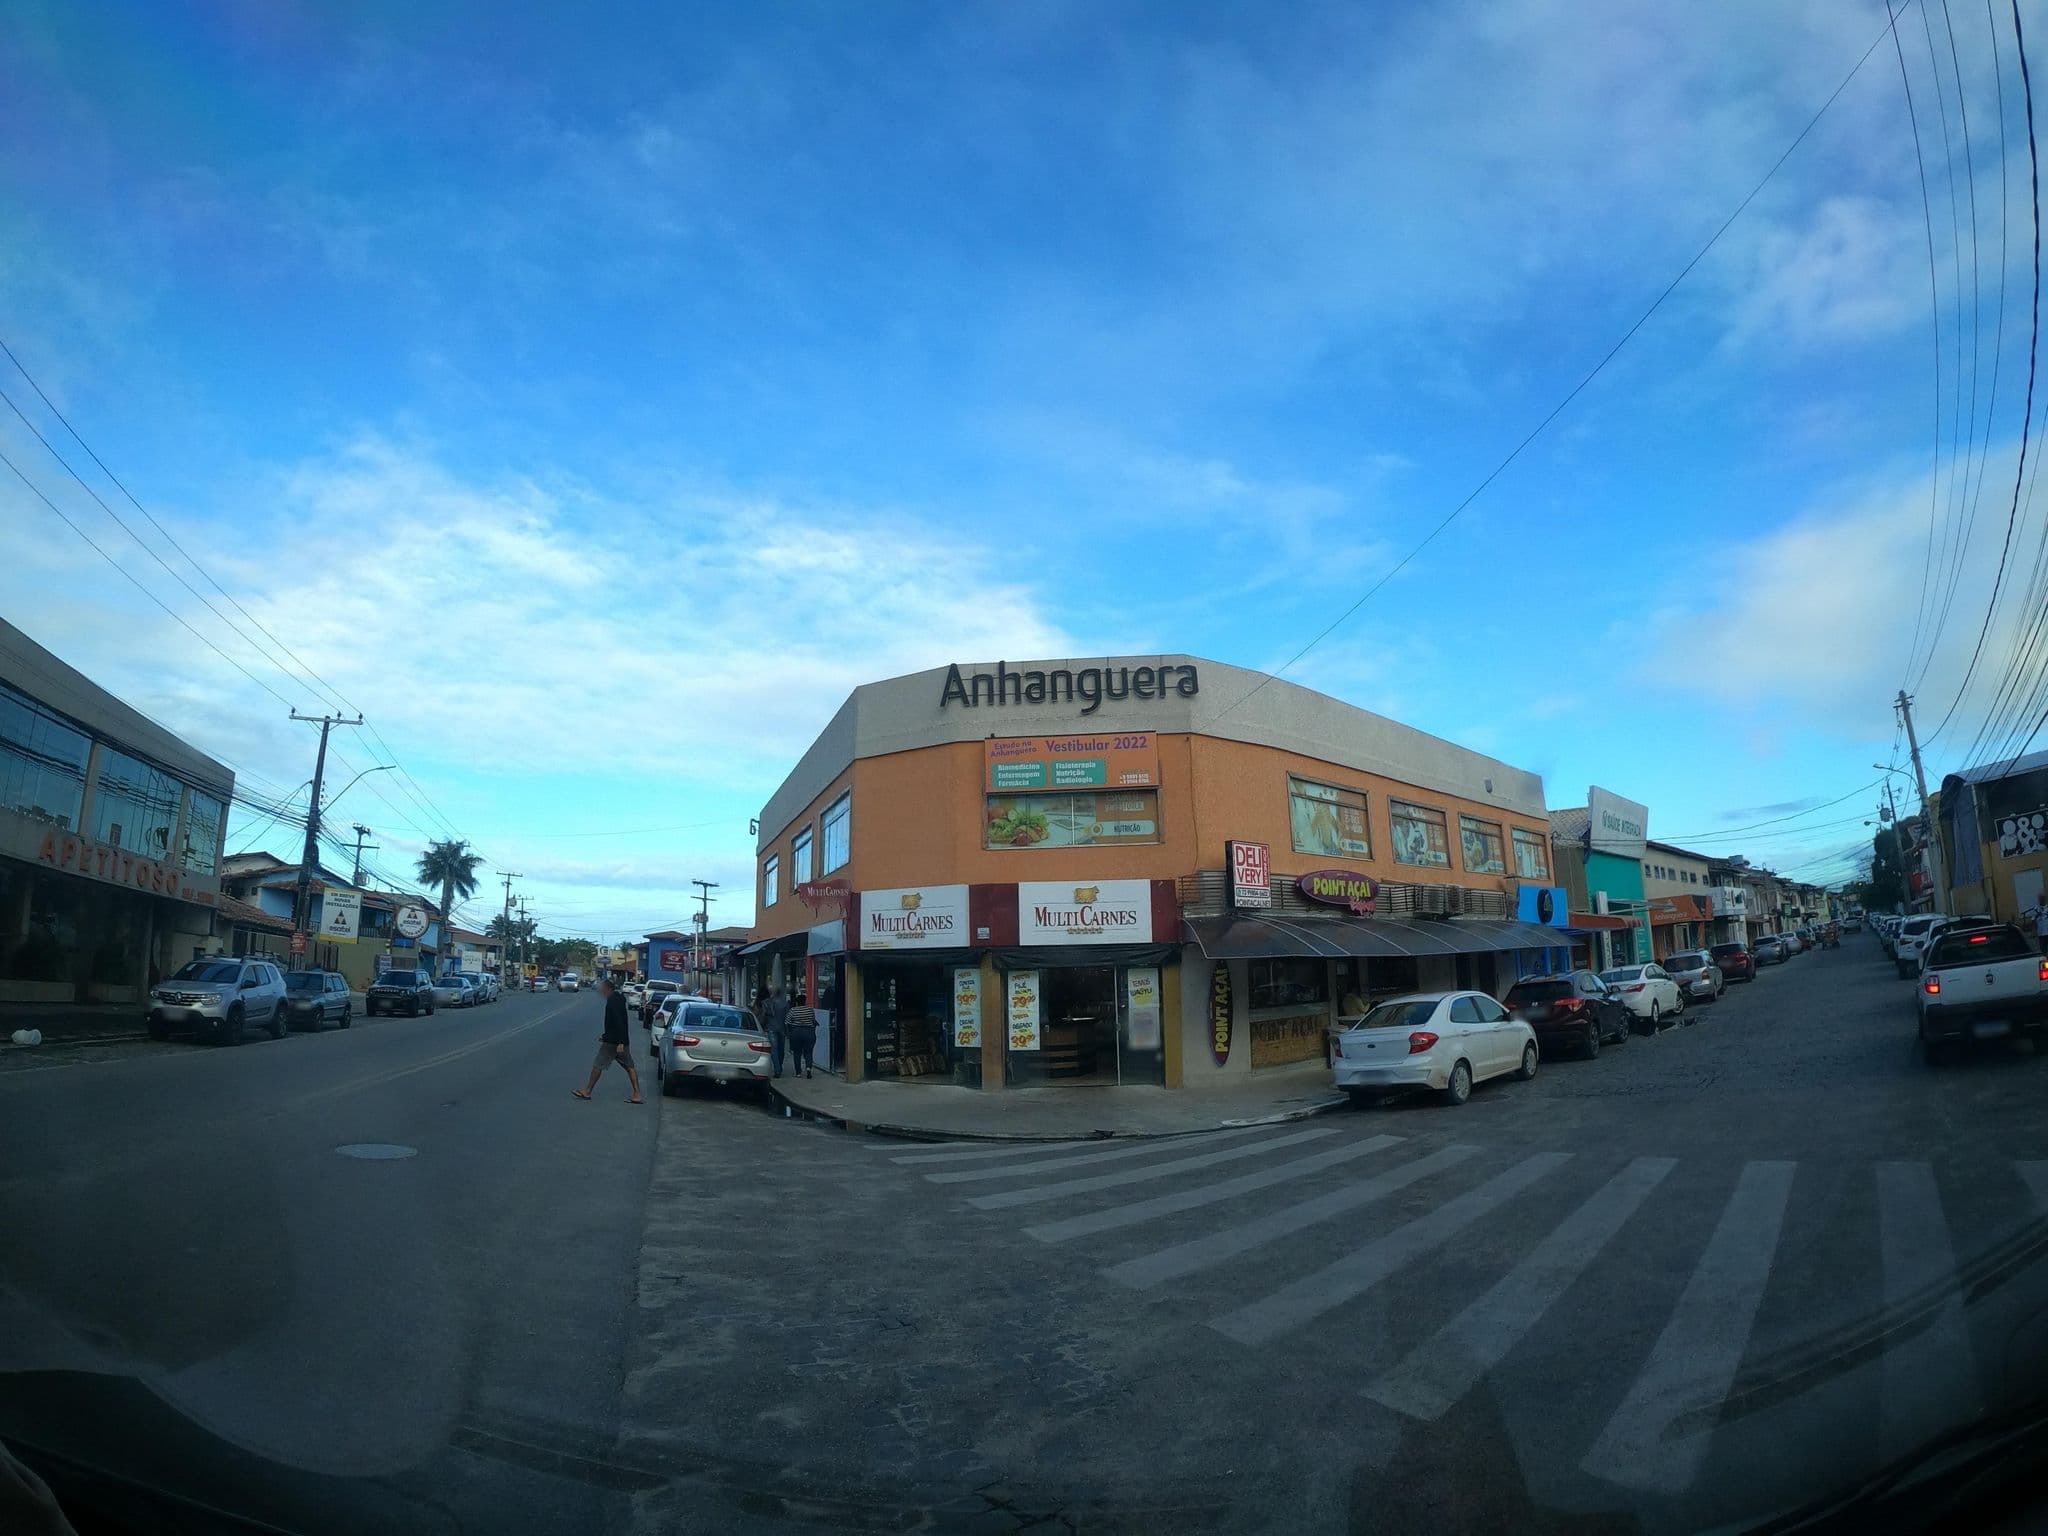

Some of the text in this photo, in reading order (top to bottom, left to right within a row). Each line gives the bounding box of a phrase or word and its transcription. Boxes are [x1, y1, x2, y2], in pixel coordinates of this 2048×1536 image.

[940, 660, 1200, 715] Anhanguera
[1045, 736, 1148, 753] Vestibular 2022
[998, 763, 1040, 771] Biomedicina
[1055, 760, 1096, 770] Fisioterapia
[1055, 769, 1086, 778] Nutrição
[998, 771, 1040, 779] Enfermagem
[1055, 776, 1093, 785] Radiologia
[1113, 823, 1141, 833] NUTRIÇÃO
[39, 834, 179, 895] APETITOSO
[1235, 845, 1262, 868] DELI
[1236, 867, 1262, 884] VERY
[1312, 877, 1346, 897] POINT
[1215, 1006, 1229, 1052] POINT
